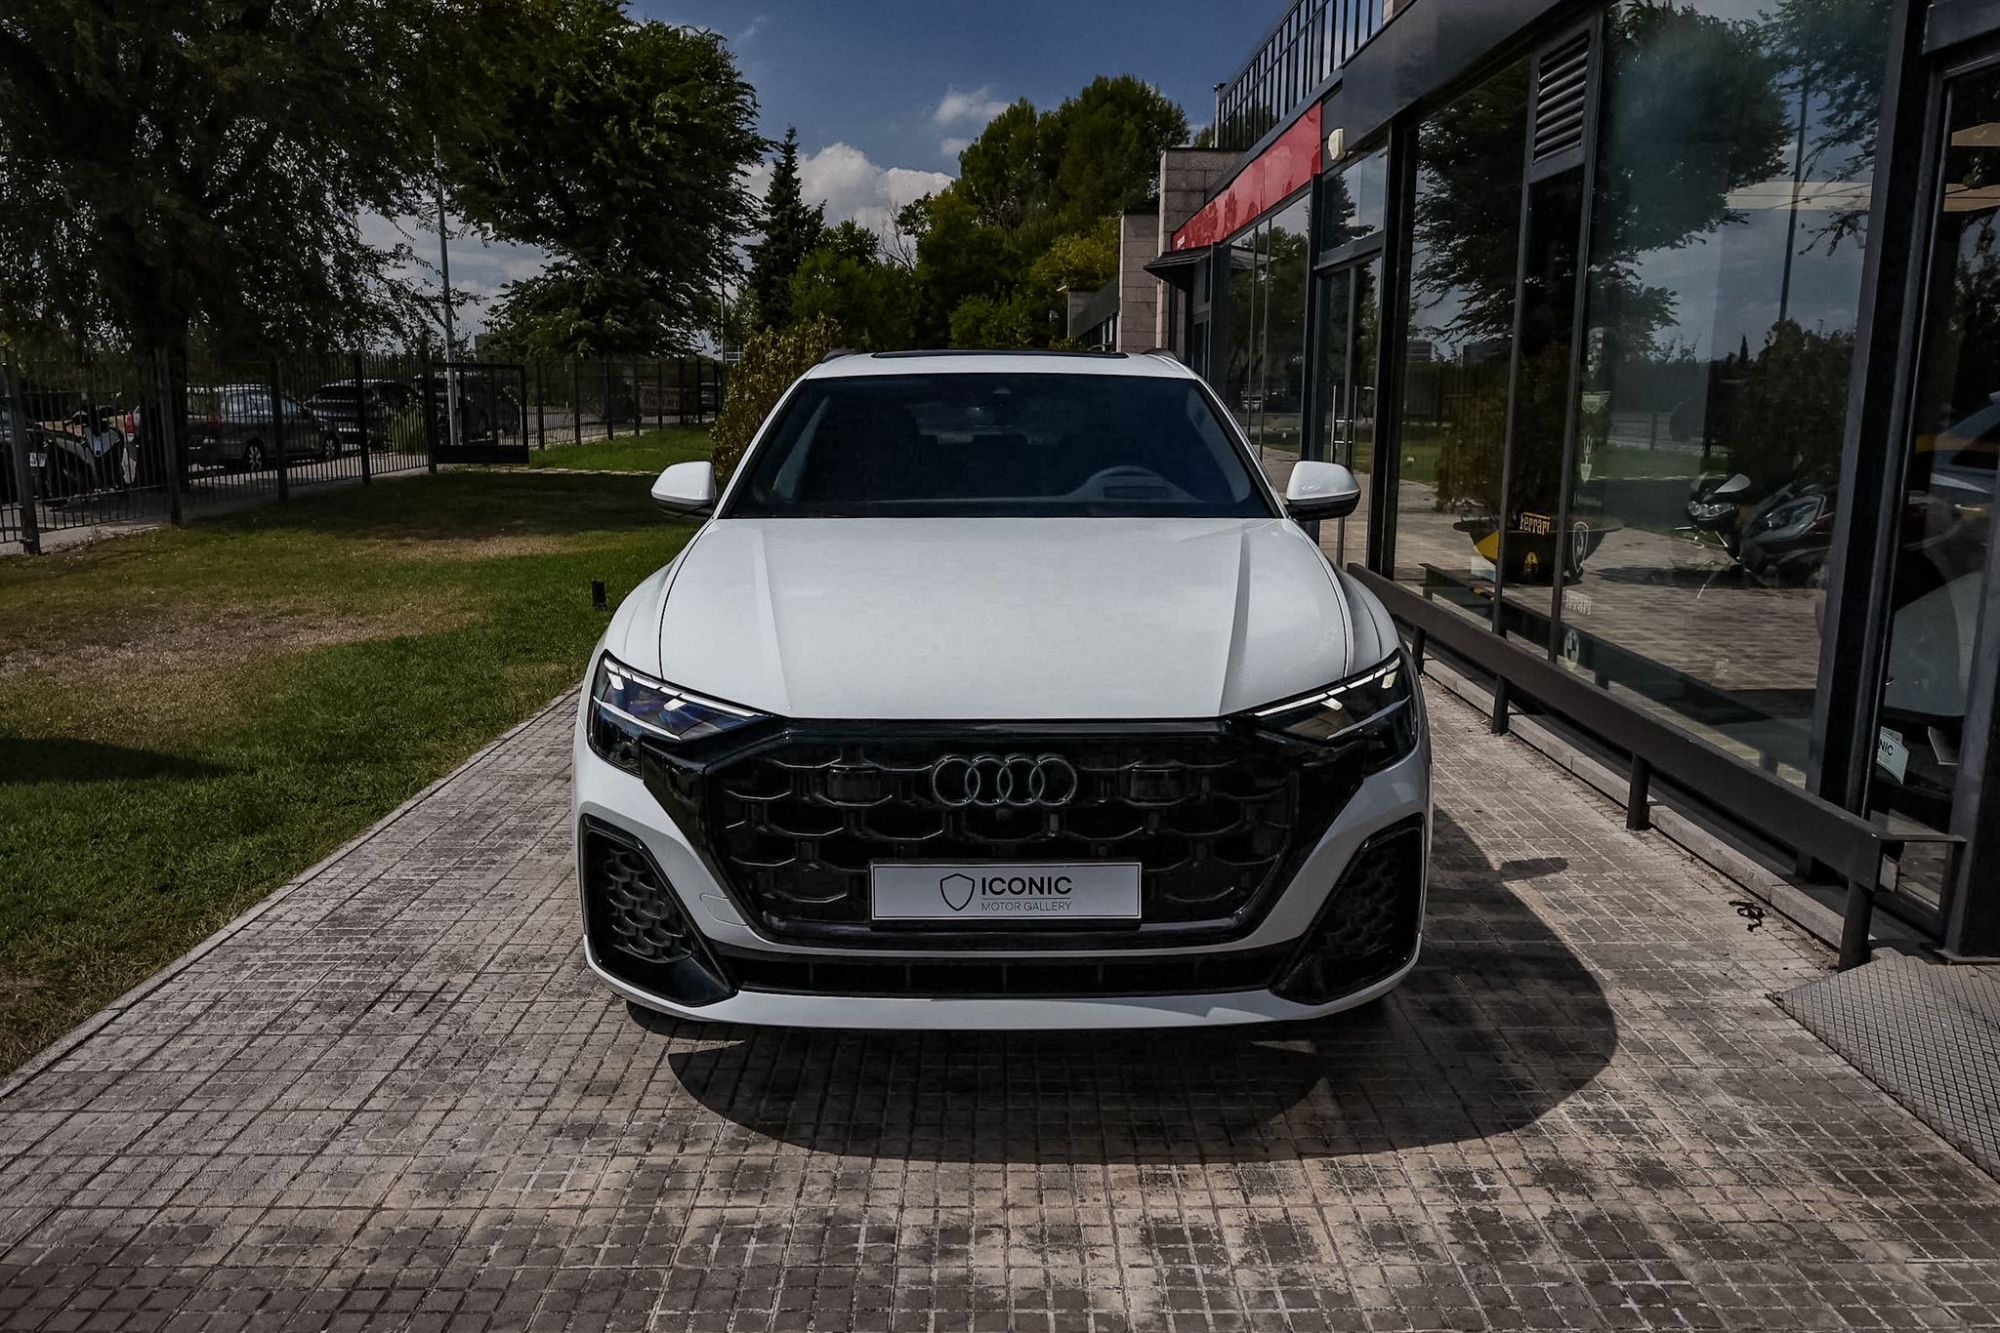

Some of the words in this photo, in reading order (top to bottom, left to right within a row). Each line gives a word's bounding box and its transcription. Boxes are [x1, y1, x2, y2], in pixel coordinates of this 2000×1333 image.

[981, 876, 1072, 896] ICONIC
[981, 901, 1021, 912] MOTOR
[1023, 901, 1072, 912] GALLERY
